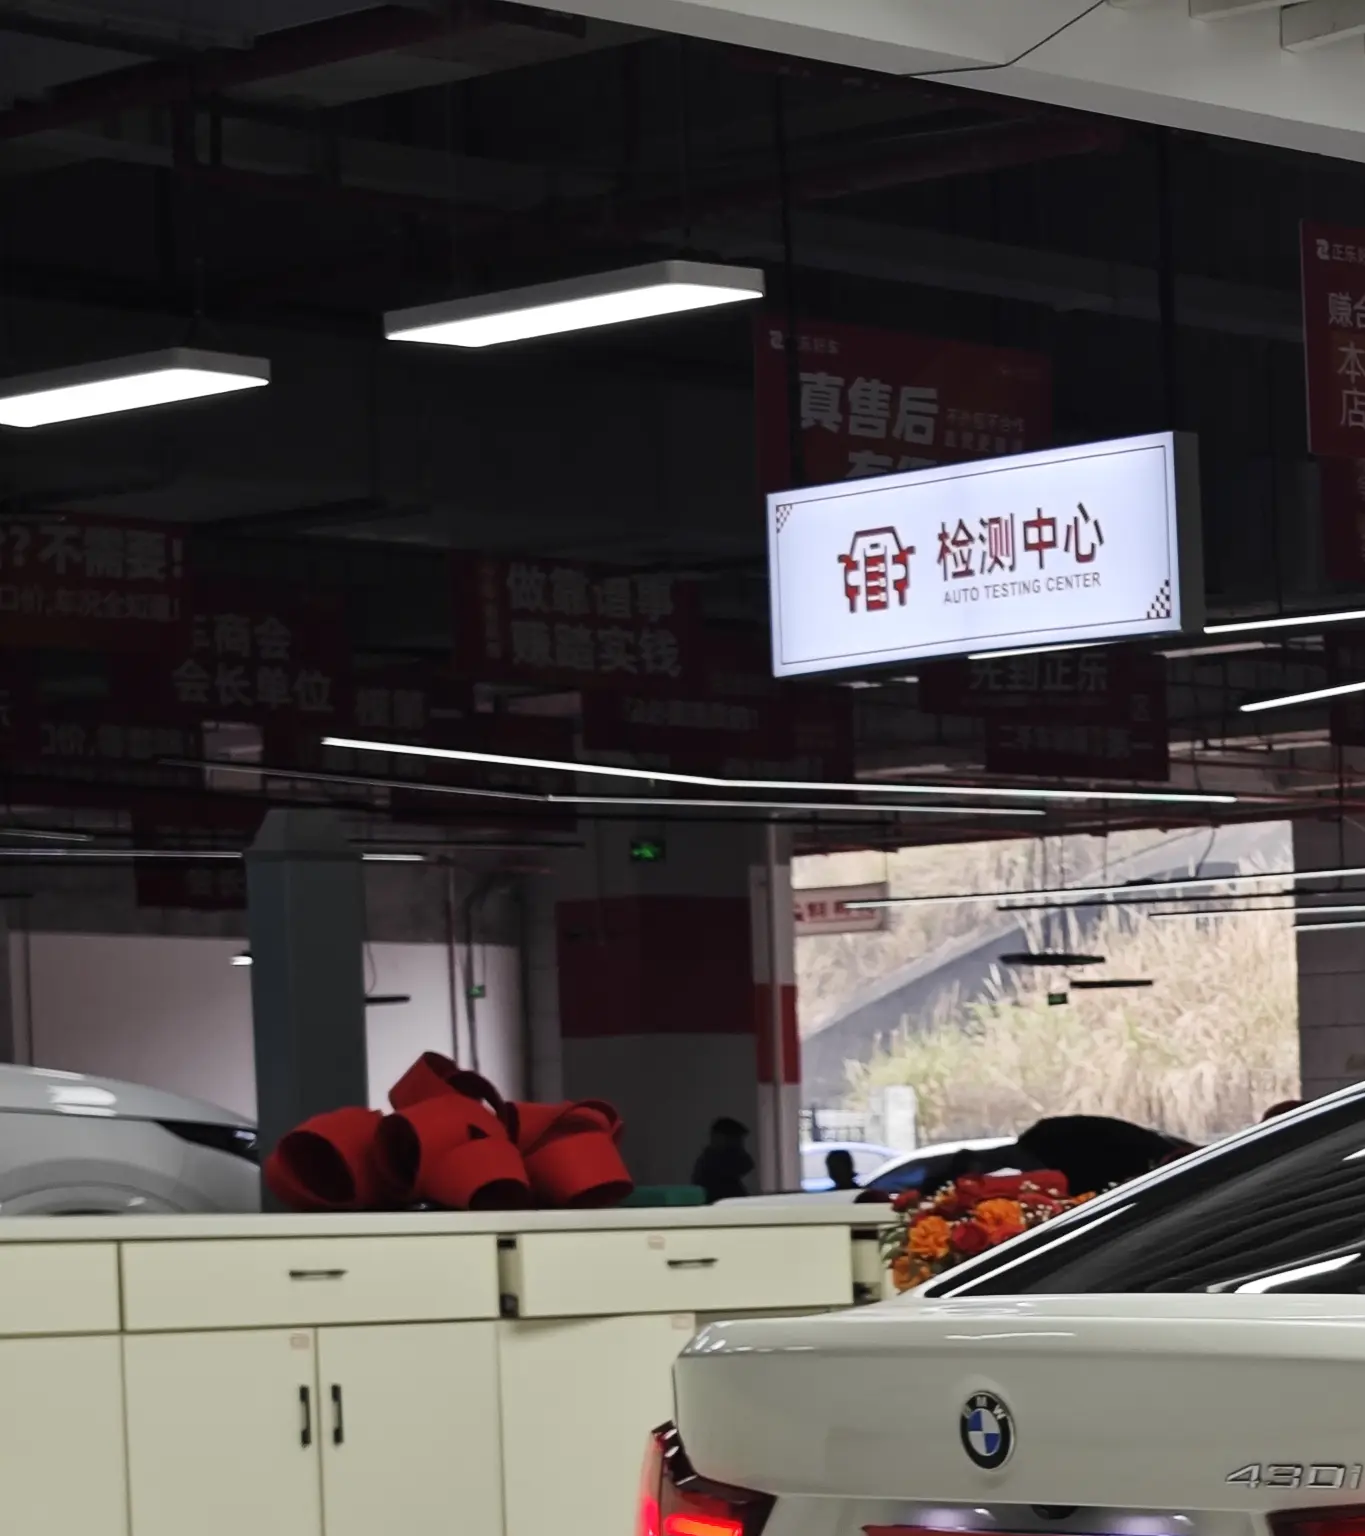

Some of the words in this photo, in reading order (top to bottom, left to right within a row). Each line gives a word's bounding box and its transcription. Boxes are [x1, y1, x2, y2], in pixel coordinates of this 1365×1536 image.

[797, 370, 942, 446] 真售后
[0, 525, 184, 582] ?不需要!
[936, 501, 1105, 581] 检测中心
[943, 586, 980, 605] AUTO
[984, 578, 1041, 600] TESTING
[1045, 570, 1102, 592] CENTER
[171, 657, 336, 711] 会长单位
[1225, 1462, 1363, 1491] 430i
